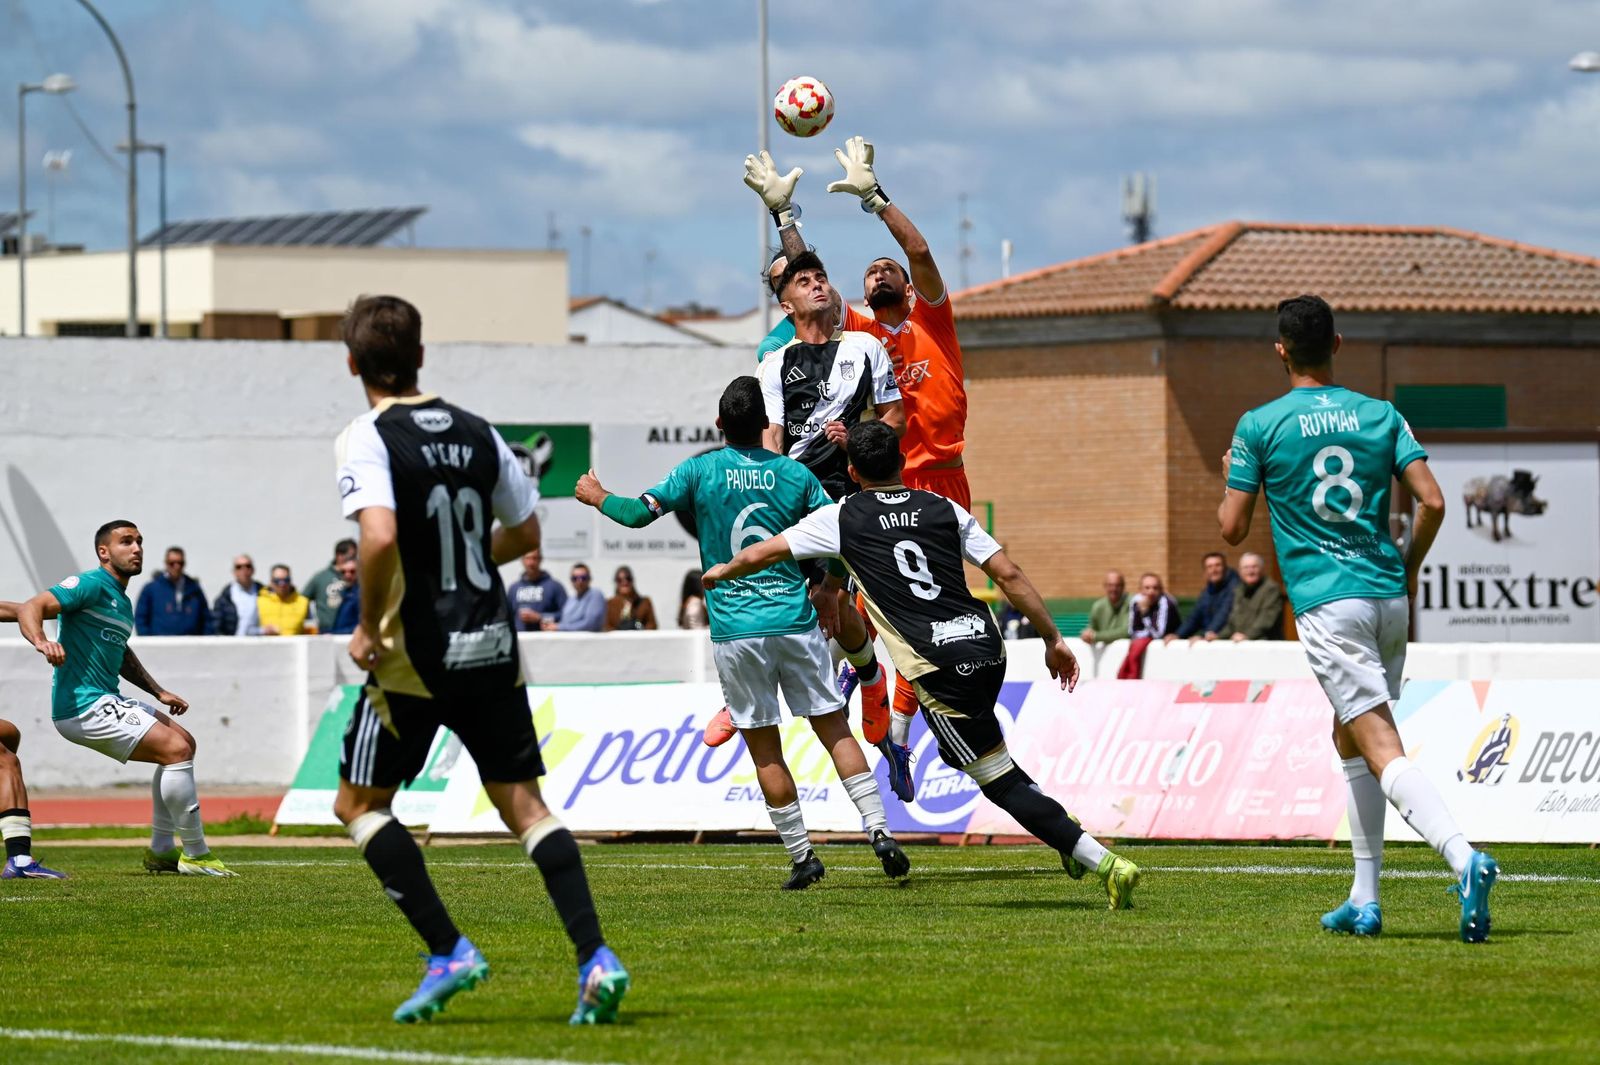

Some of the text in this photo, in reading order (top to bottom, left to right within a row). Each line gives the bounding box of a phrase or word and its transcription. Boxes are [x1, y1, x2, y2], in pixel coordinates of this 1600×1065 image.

[1299, 410, 1360, 438] RUYMAN
[726, 469, 776, 493] PAJUELO
[1312, 445, 1363, 523] 8
[730, 502, 776, 559] 6
[879, 508, 921, 530] NANÉ
[893, 540, 941, 600] 9
[1421, 564, 1597, 610] iluxtre
[1518, 731, 1600, 783] DECO
[725, 787, 829, 802] ENGIA
[916, 774, 979, 800] HORA
